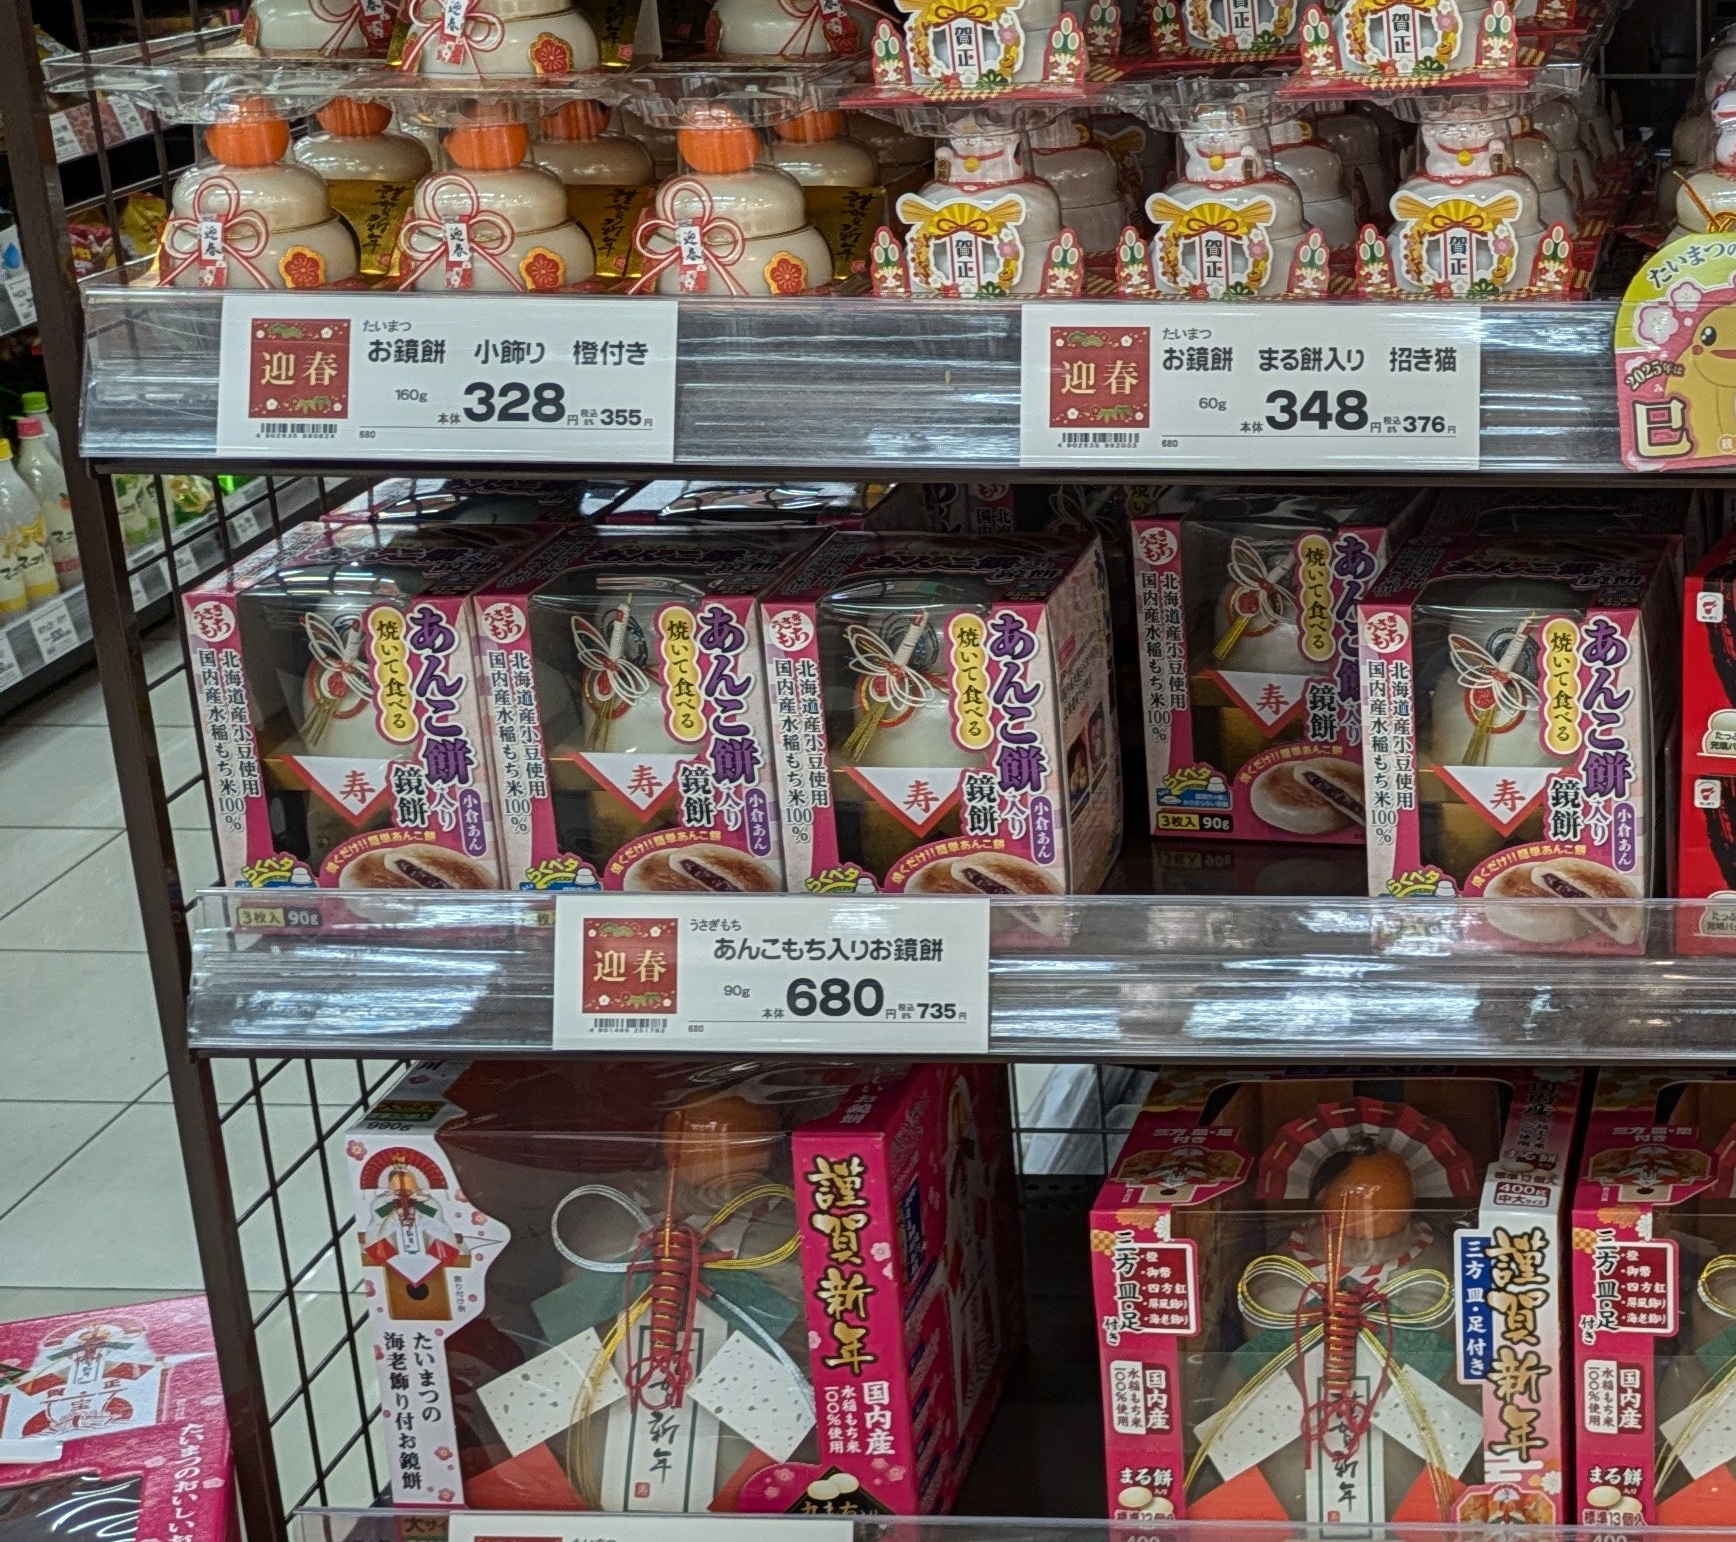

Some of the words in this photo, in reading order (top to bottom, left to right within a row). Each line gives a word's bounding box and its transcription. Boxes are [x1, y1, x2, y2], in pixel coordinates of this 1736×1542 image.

[362, 320, 412, 332] たいまつ
[1162, 327, 1212, 340] たいまつ
[261, 351, 339, 386] 迎春
[367, 339, 446, 364] お鏡餅
[473, 339, 546, 365] 小飾り
[573, 340, 649, 366] 橙付き
[1162, 347, 1233, 372] お鏡餅
[1259, 347, 1365, 372] まる餅入り
[1389, 347, 1457, 372] 招き猫
[1061, 360, 1140, 395] 迎春
[395, 389, 427, 403] 160g
[463, 383, 565, 423] 328
[1198, 397, 1227, 411] 60g
[1265, 390, 1368, 431] 348
[376, 621, 407, 730] 焼いて食べる
[222, 651, 260, 798] 北海道産小豆使用
[393, 768, 429, 827] 鏡餅
[462, 794, 485, 853] 小倉あん
[1160, 814, 1197, 829] 3枚入
[1202, 815, 1230, 831] 90g
[690, 919, 741, 931] うさぎもち
[594, 950, 667, 983] 迎春
[714, 938, 943, 962] あんこもち入りお鏡餅
[723, 985, 751, 998] 90g
[786, 978, 884, 1018] 680
[806, 1154, 876, 1375] 謹賀新年
[1486, 1226, 1550, 1462] 謹賀新年
[412, 1331, 442, 1422] たいまつの
[383, 1331, 424, 1491] 海老飾り付お鏡餅
[863, 1380, 896, 1456] 国内産
